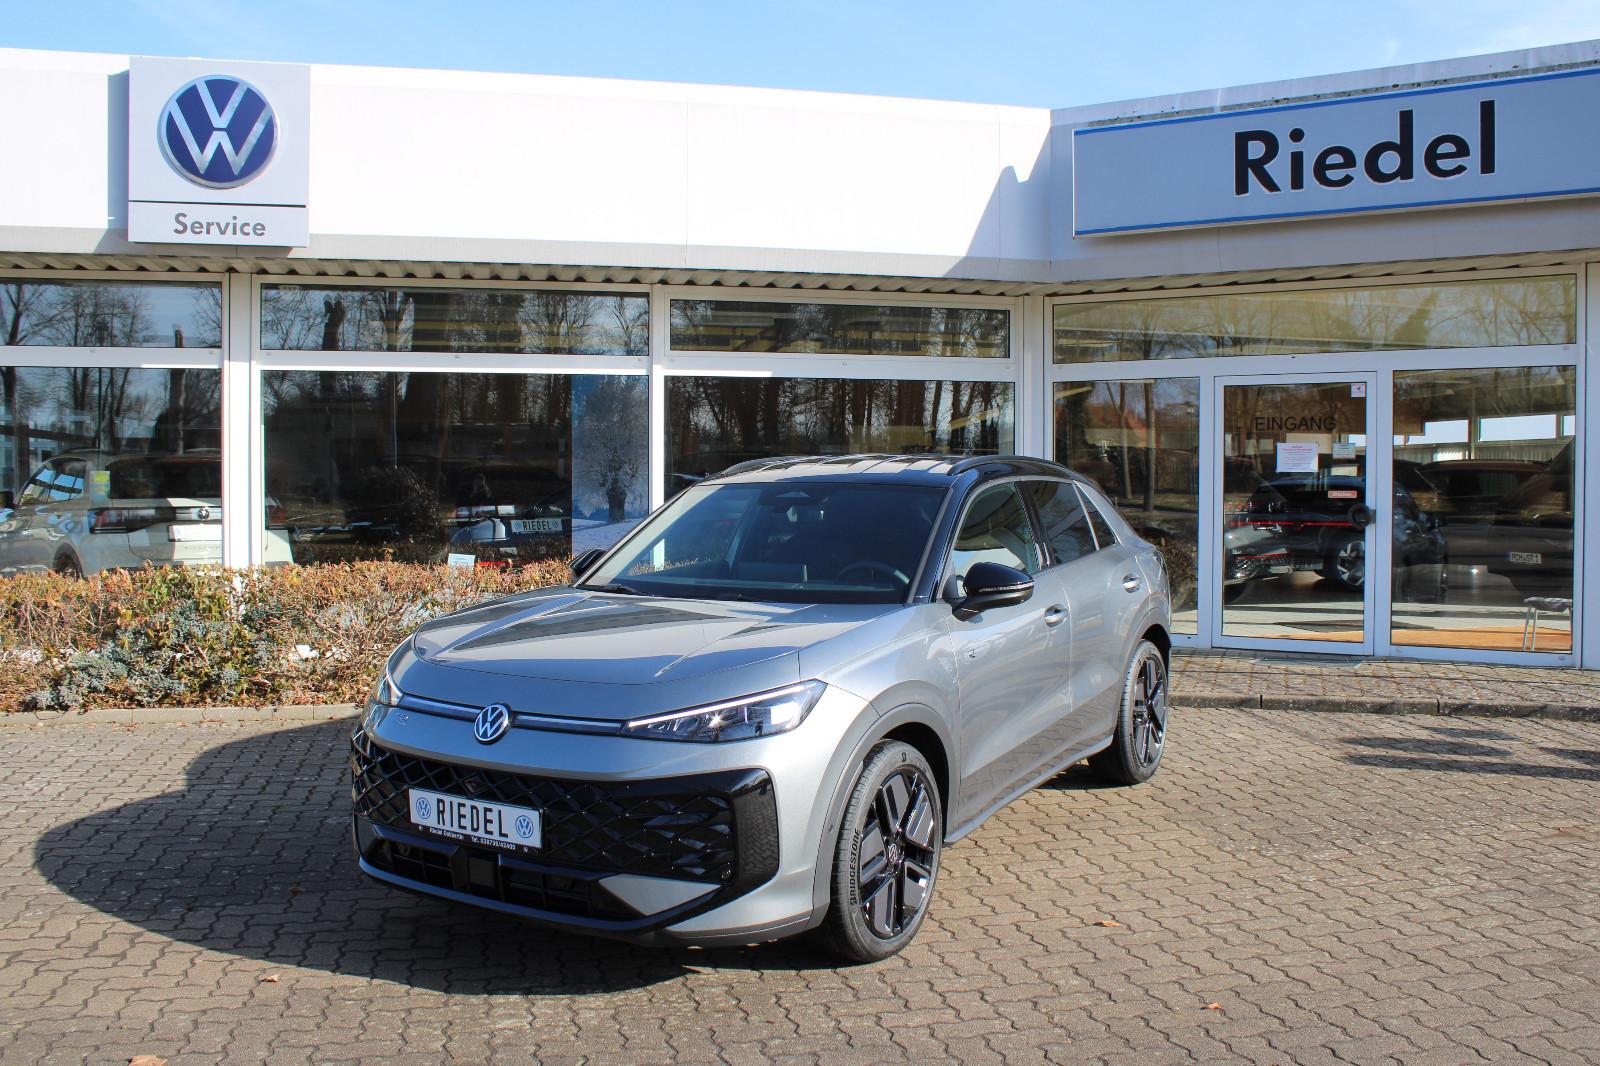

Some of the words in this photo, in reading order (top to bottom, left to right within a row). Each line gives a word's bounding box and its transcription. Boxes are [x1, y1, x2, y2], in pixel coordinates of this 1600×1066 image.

[1235, 100, 1495, 196] Riedel
[173, 212, 267, 237] Service
[1254, 415, 1337, 431] EINGANG
[522, 520, 552, 531] RIEDEL
[436, 798, 509, 839] RIEDEL
[850, 828, 861, 906] BRIDGESTONE
